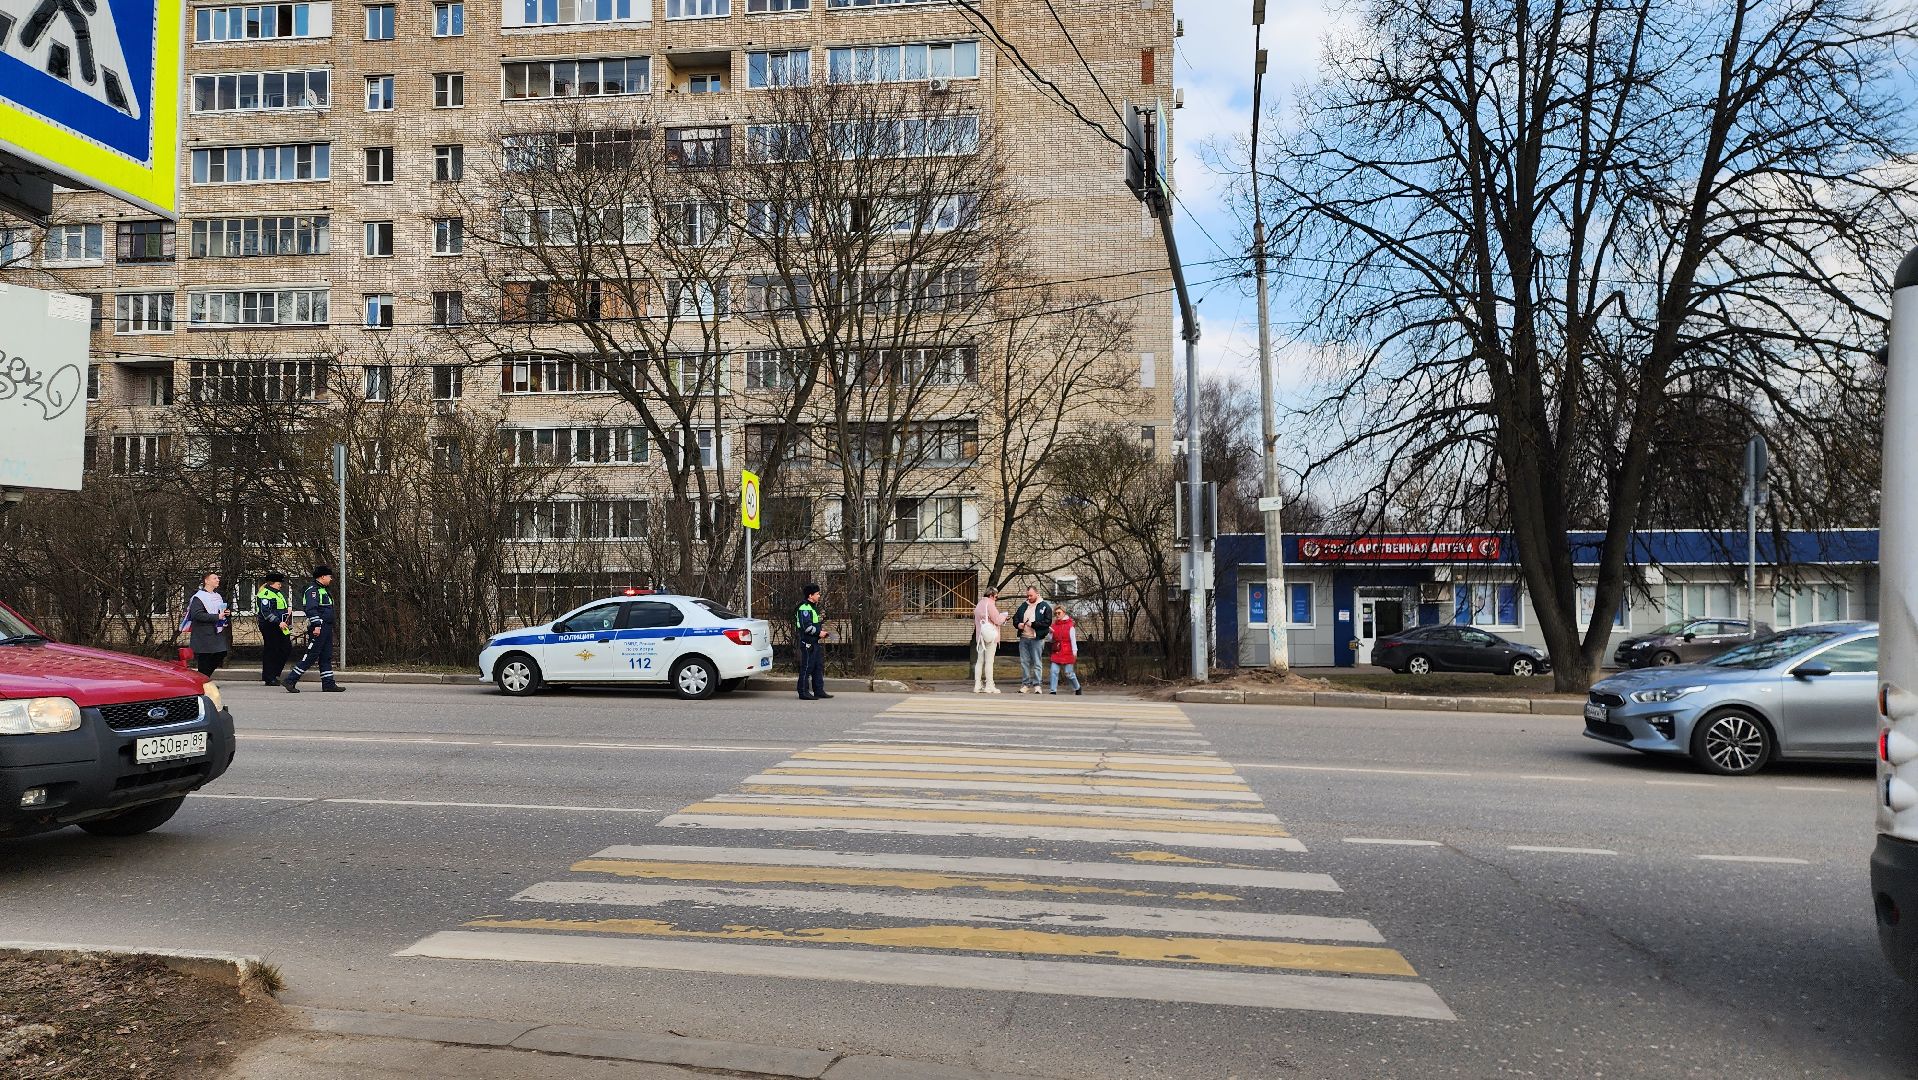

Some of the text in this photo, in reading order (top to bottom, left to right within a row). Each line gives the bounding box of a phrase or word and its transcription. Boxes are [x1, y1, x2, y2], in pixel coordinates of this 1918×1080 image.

[1324, 542, 1473, 554] ГОСУДАРСТВЕННАЯ АПТЕКА
[558, 633, 595, 641] ПОЛИЦИЯ
[629, 657, 651, 669] 112
